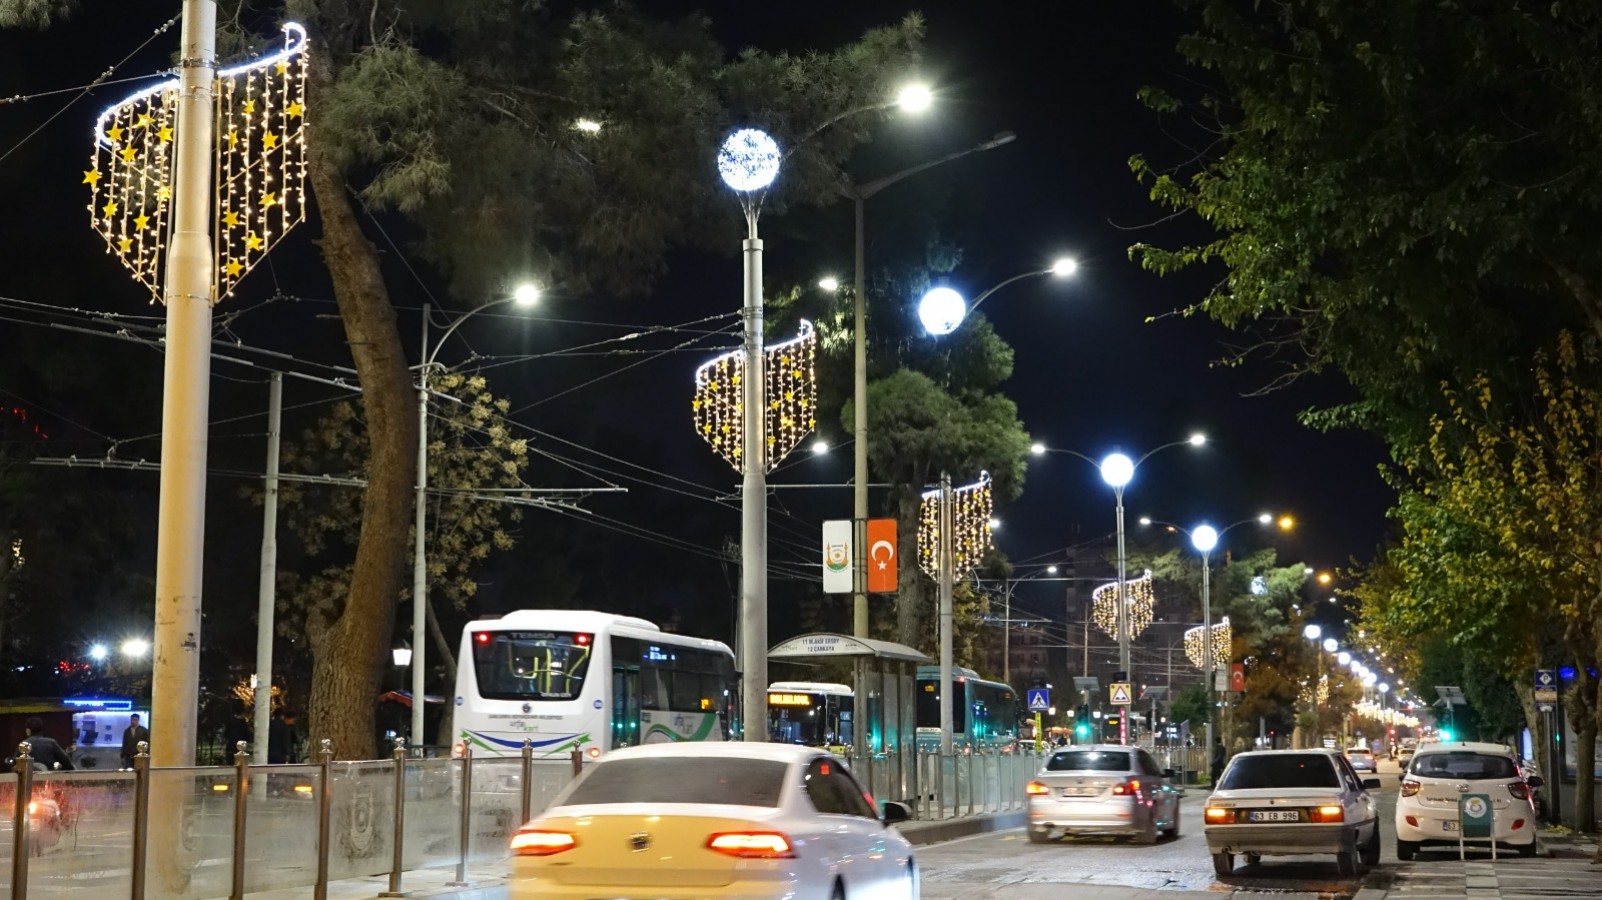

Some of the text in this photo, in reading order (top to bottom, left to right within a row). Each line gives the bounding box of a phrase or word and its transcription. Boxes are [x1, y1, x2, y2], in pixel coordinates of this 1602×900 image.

[1255, 812, 1298, 821] 63 EB 996
